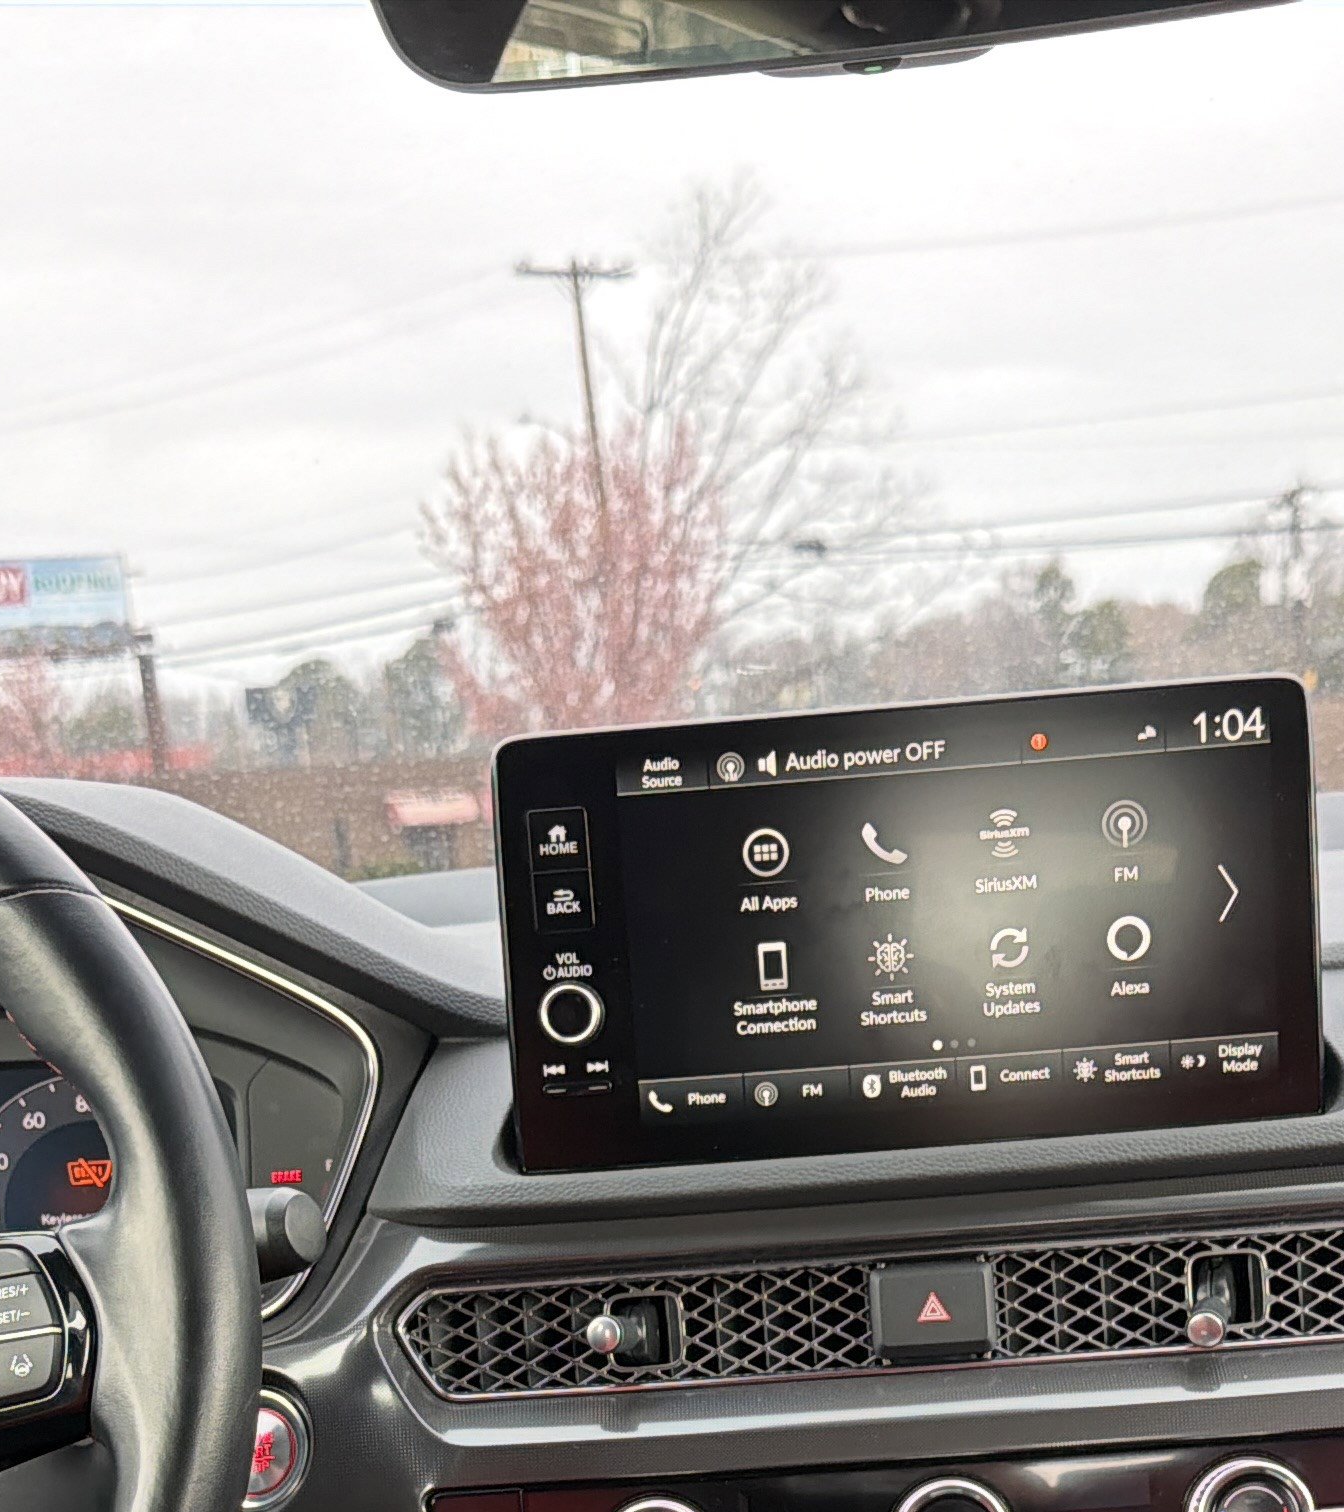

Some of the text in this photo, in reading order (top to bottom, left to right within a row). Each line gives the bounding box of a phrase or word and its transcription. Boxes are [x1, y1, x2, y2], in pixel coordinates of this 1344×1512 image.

[1192, 706, 1266, 744] 1:04
[785, 739, 946, 772] Audio power OFF
[643, 757, 680, 773] Audio
[641, 774, 683, 789] Source
[539, 842, 578, 856] HOME
[1114, 865, 1139, 883] FM
[975, 875, 1038, 894] SiriusXM
[865, 886, 910, 902] Phone
[546, 901, 581, 915] BACK
[740, 895, 798, 912] All Apps
[556, 953, 580, 965] VOL
[557, 965, 593, 978] AUDIO
[985, 981, 1036, 999] System
[1110, 981, 1150, 997] Alexa
[872, 990, 914, 1006] Smart
[733, 998, 818, 1017] Smartphone
[983, 1000, 1041, 1019] Updates
[860, 1008, 927, 1027] Shortcuts
[736, 1017, 817, 1036] Connection
[1218, 1042, 1263, 1058] Display
[1114, 1051, 1150, 1066] Smart
[1222, 1059, 1259, 1074] Mode
[888, 1067, 948, 1084] Bluetooth
[999, 1067, 1051, 1084] Connect
[1104, 1067, 1162, 1084] Shortcuts
[802, 1083, 823, 1097] FM
[900, 1084, 937, 1099] Audio
[75, 1094, 92, 1113] 8
[687, 1091, 727, 1106] Phone
[22, 1111, 46, 1130] 60
